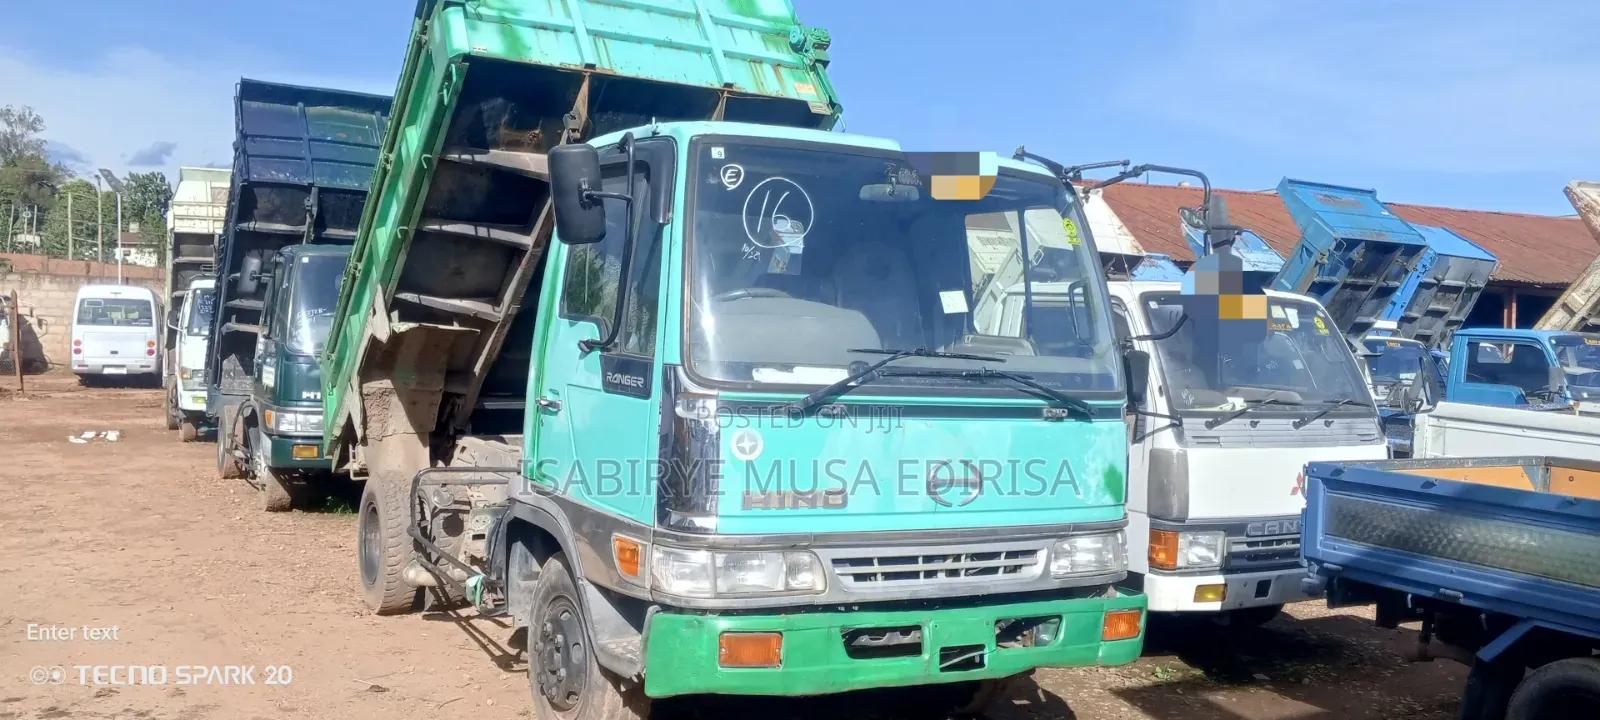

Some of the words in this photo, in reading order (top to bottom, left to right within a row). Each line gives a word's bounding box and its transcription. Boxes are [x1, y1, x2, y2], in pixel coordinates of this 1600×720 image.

[757, 190, 790, 233] 16
[606, 371, 645, 388] RANGER
[742, 488, 848, 511] HINO
